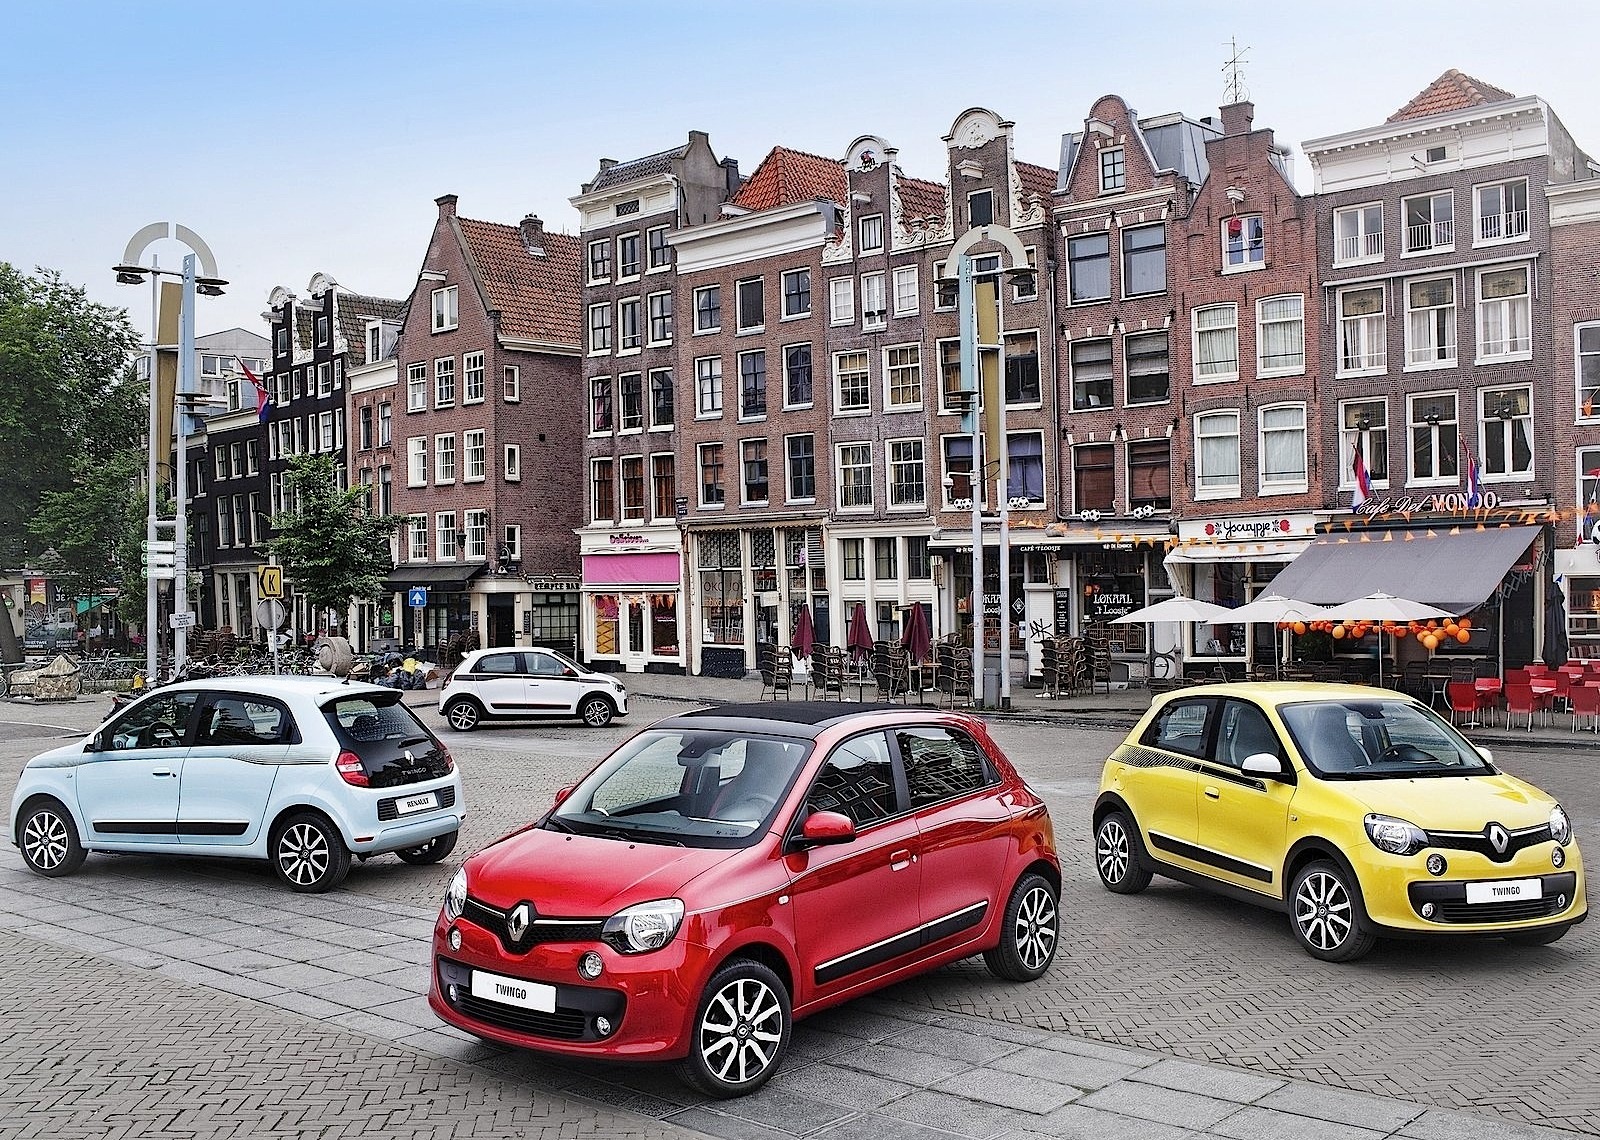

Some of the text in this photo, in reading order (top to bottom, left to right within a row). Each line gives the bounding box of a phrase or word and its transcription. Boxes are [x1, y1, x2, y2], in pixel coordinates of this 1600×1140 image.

[1392, 495, 1431, 513] Del
[1431, 491, 1497, 512] MONDO
[268, 574, 276, 592] K
[565, 582, 580, 590] BAR
[1093, 593, 1133, 605] LOKAAL
[401, 766, 427, 776] TWINGO
[406, 797, 430, 808] RENAULT
[1492, 886, 1520, 896] TWINGO
[495, 983, 527, 1000] TWINGO
